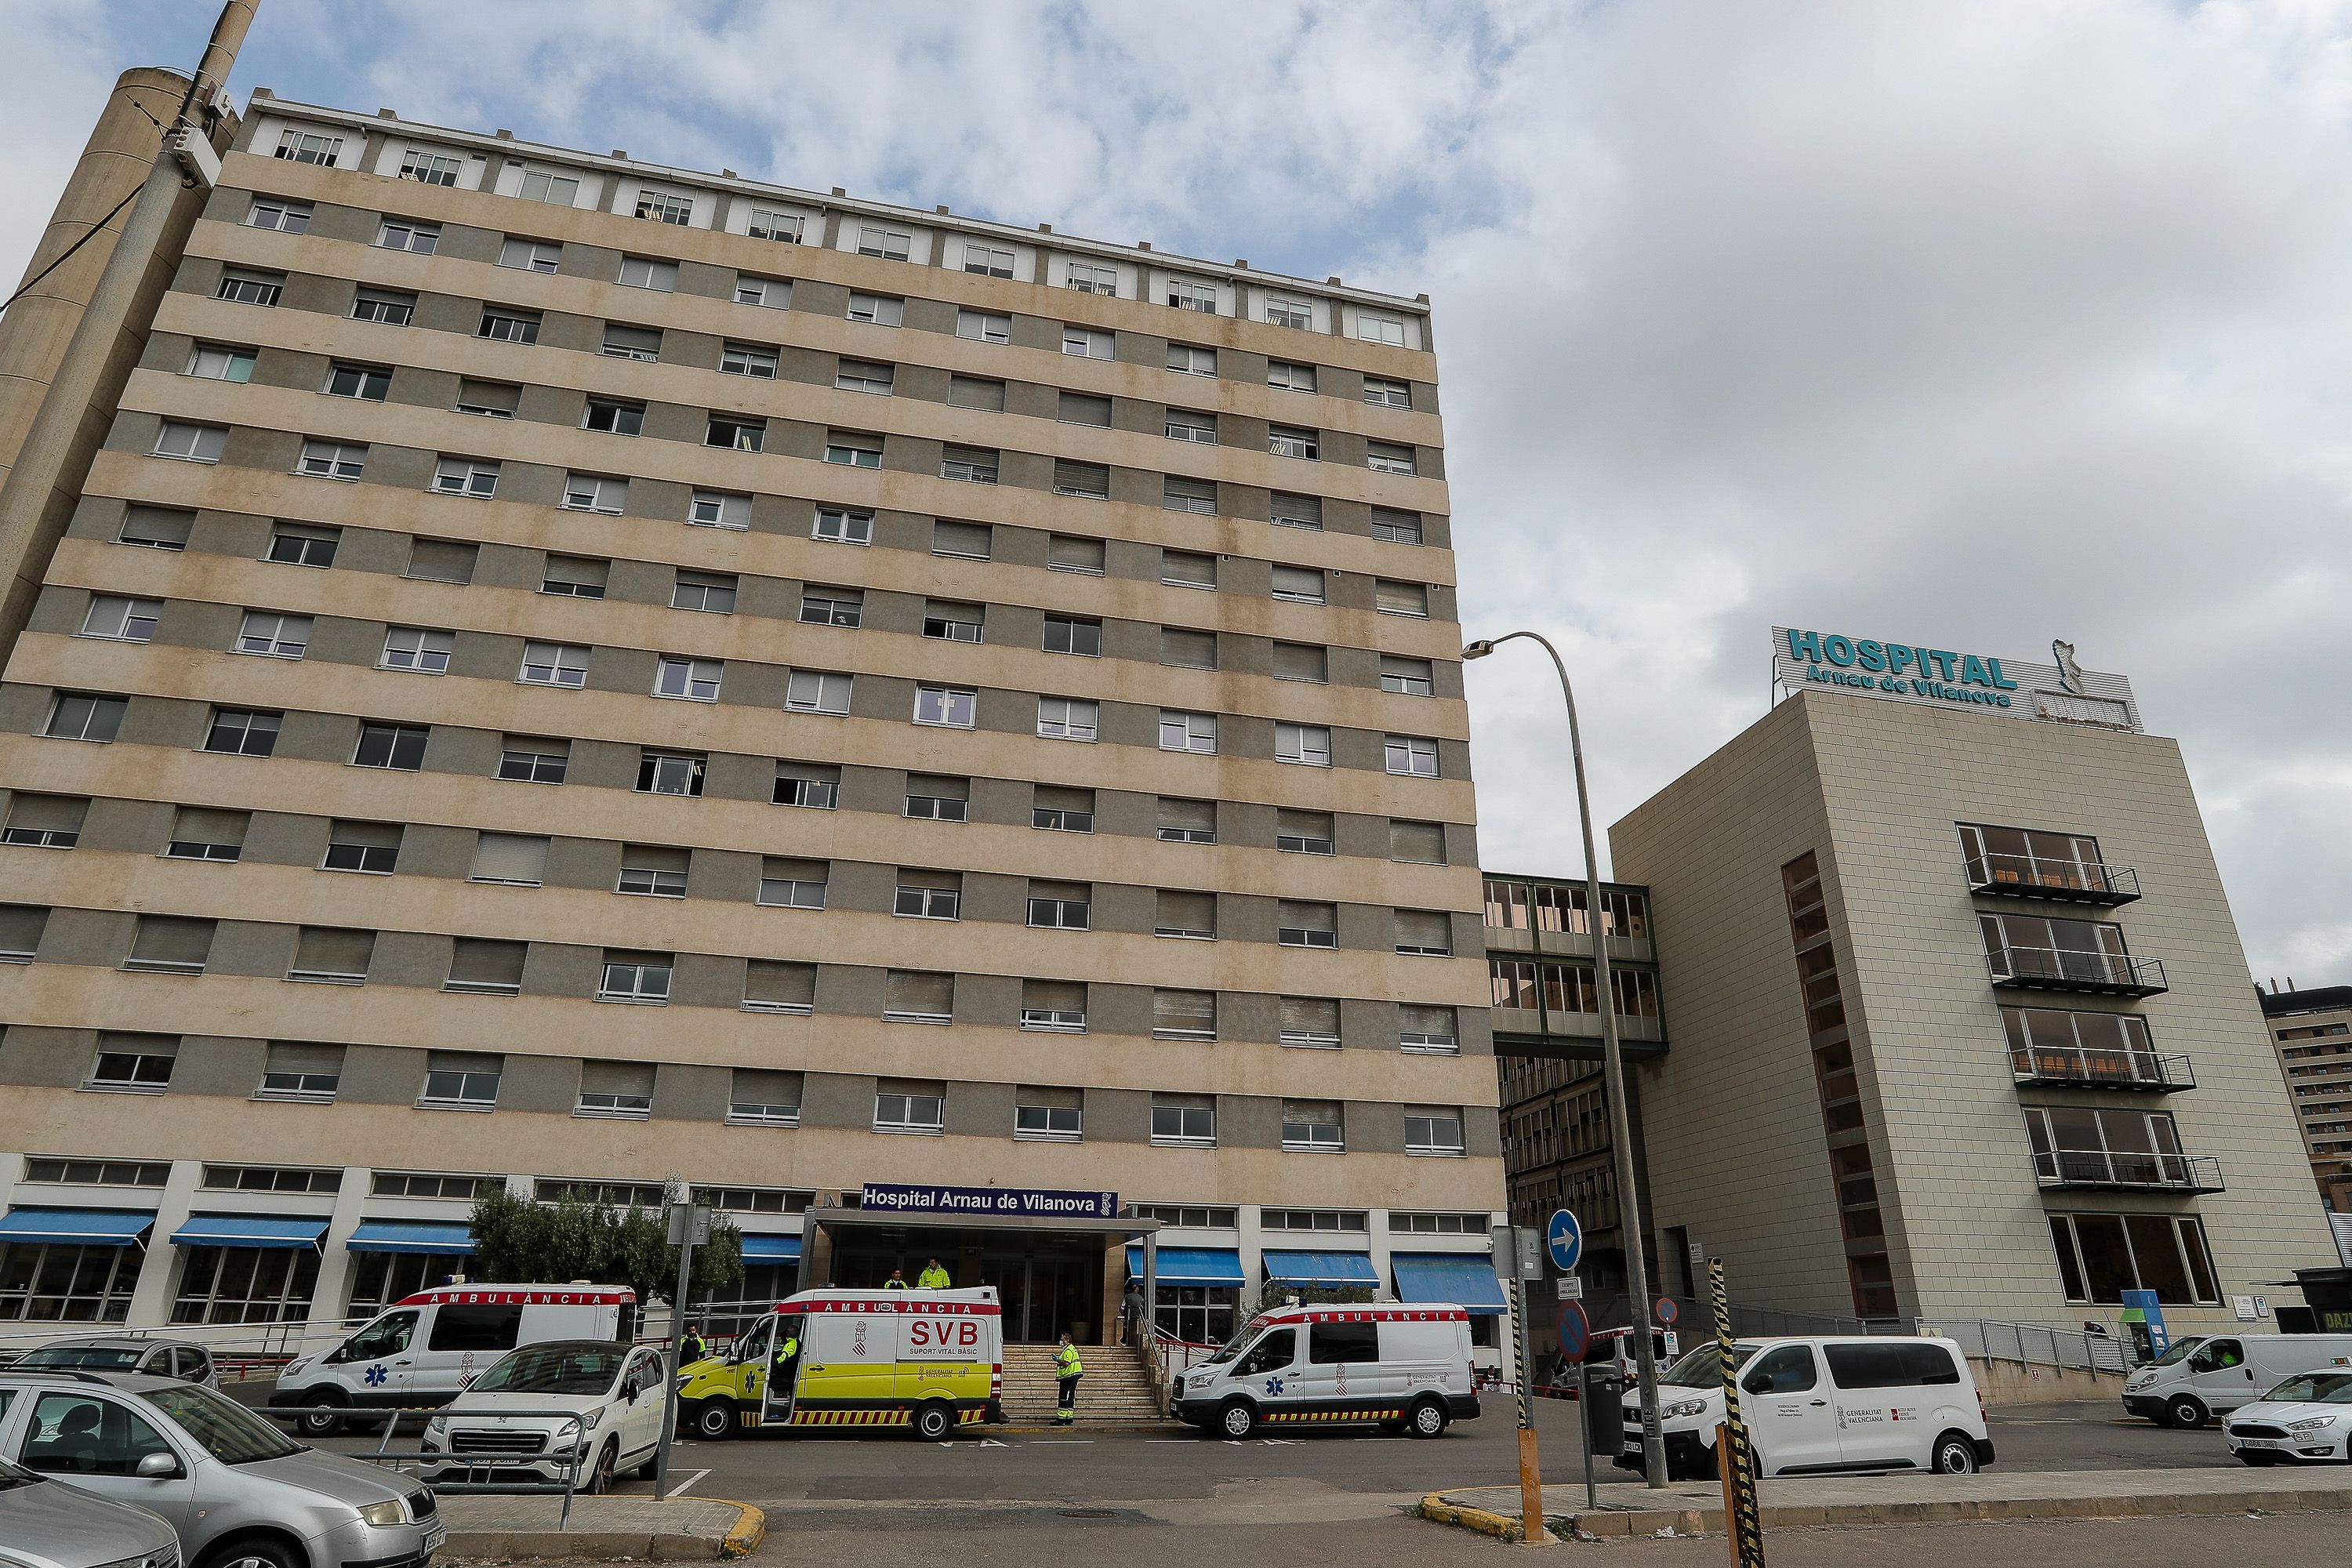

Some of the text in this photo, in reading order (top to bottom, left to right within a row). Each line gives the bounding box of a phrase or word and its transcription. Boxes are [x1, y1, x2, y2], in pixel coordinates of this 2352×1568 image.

[1788, 629, 2018, 689] HOSPITAL
[1806, 665, 2012, 706] Arnau de Vilanova
[863, 1189, 1094, 1211] Hospital Arnau de Vilanova
[430, 1292, 601, 1304] AMBULÀNCIA
[825, 1302, 971, 1314] AMBULÀNCIA
[1304, 1310, 1456, 1323] AMBULÀNCIA
[2325, 1312, 2352, 1328] DAZ
[910, 1320, 978, 1347] SVB
